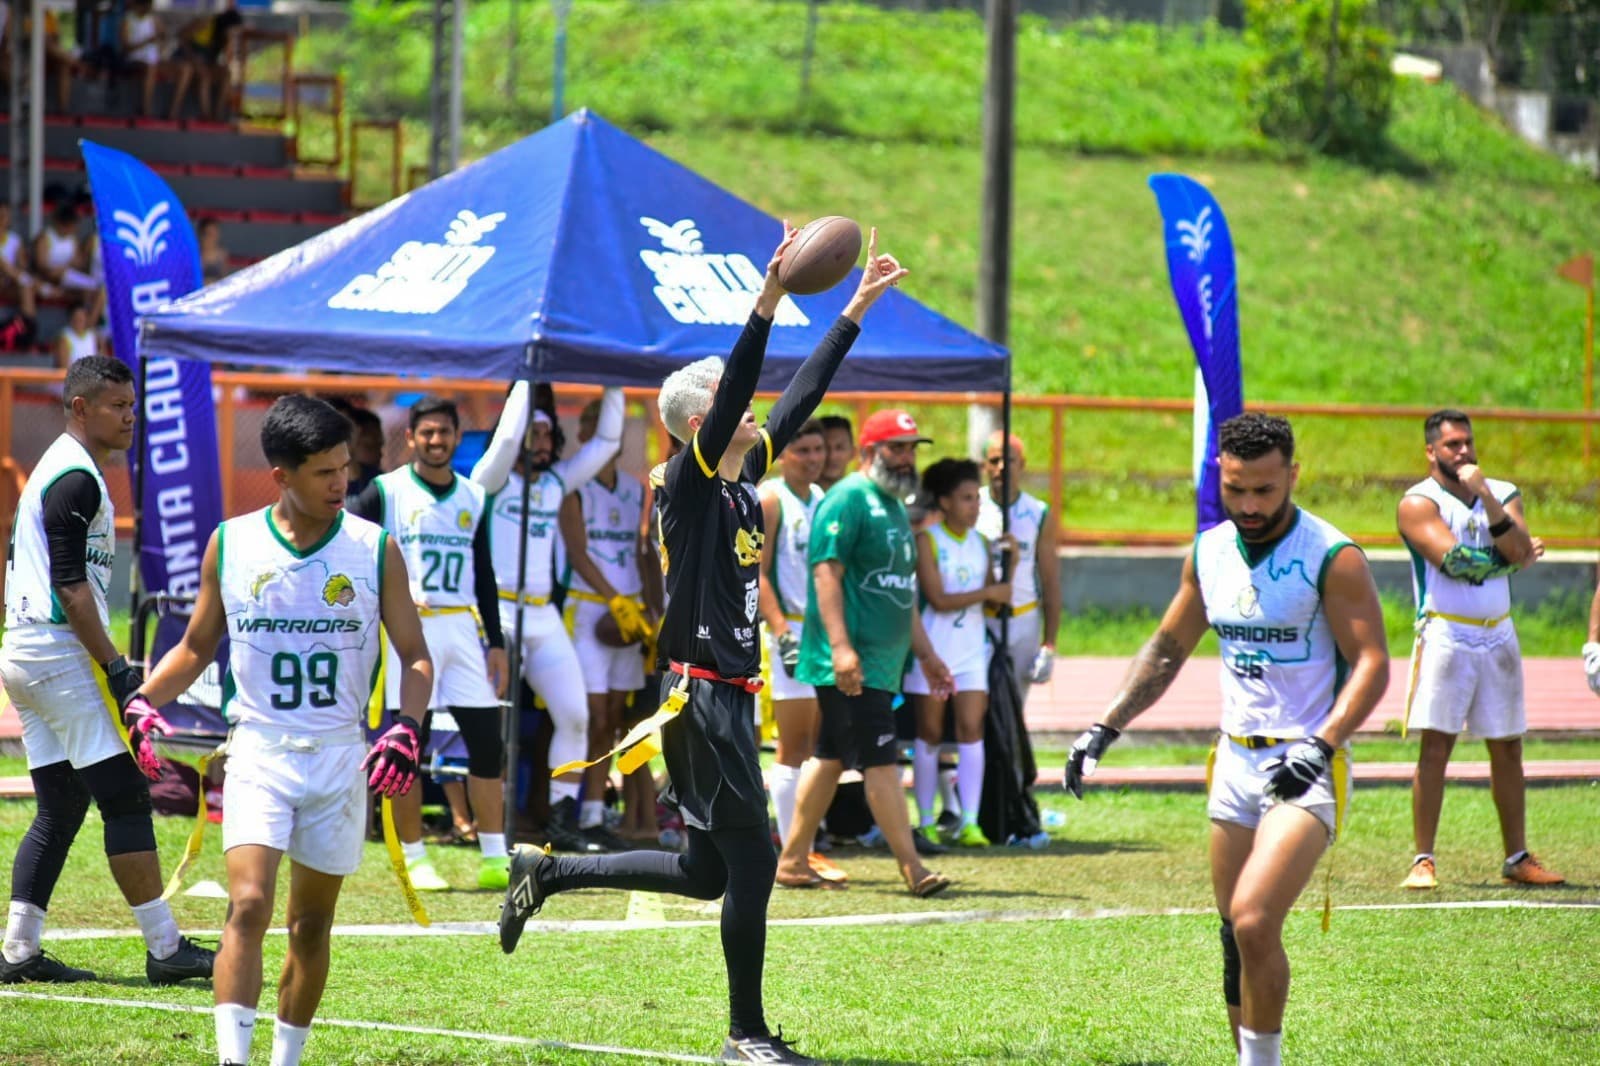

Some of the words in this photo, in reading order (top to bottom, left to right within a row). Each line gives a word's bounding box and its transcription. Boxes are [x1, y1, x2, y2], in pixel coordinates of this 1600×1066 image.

[421, 550, 464, 593] 20
[235, 617, 363, 634] WARRIORS
[270, 651, 339, 711] 99
